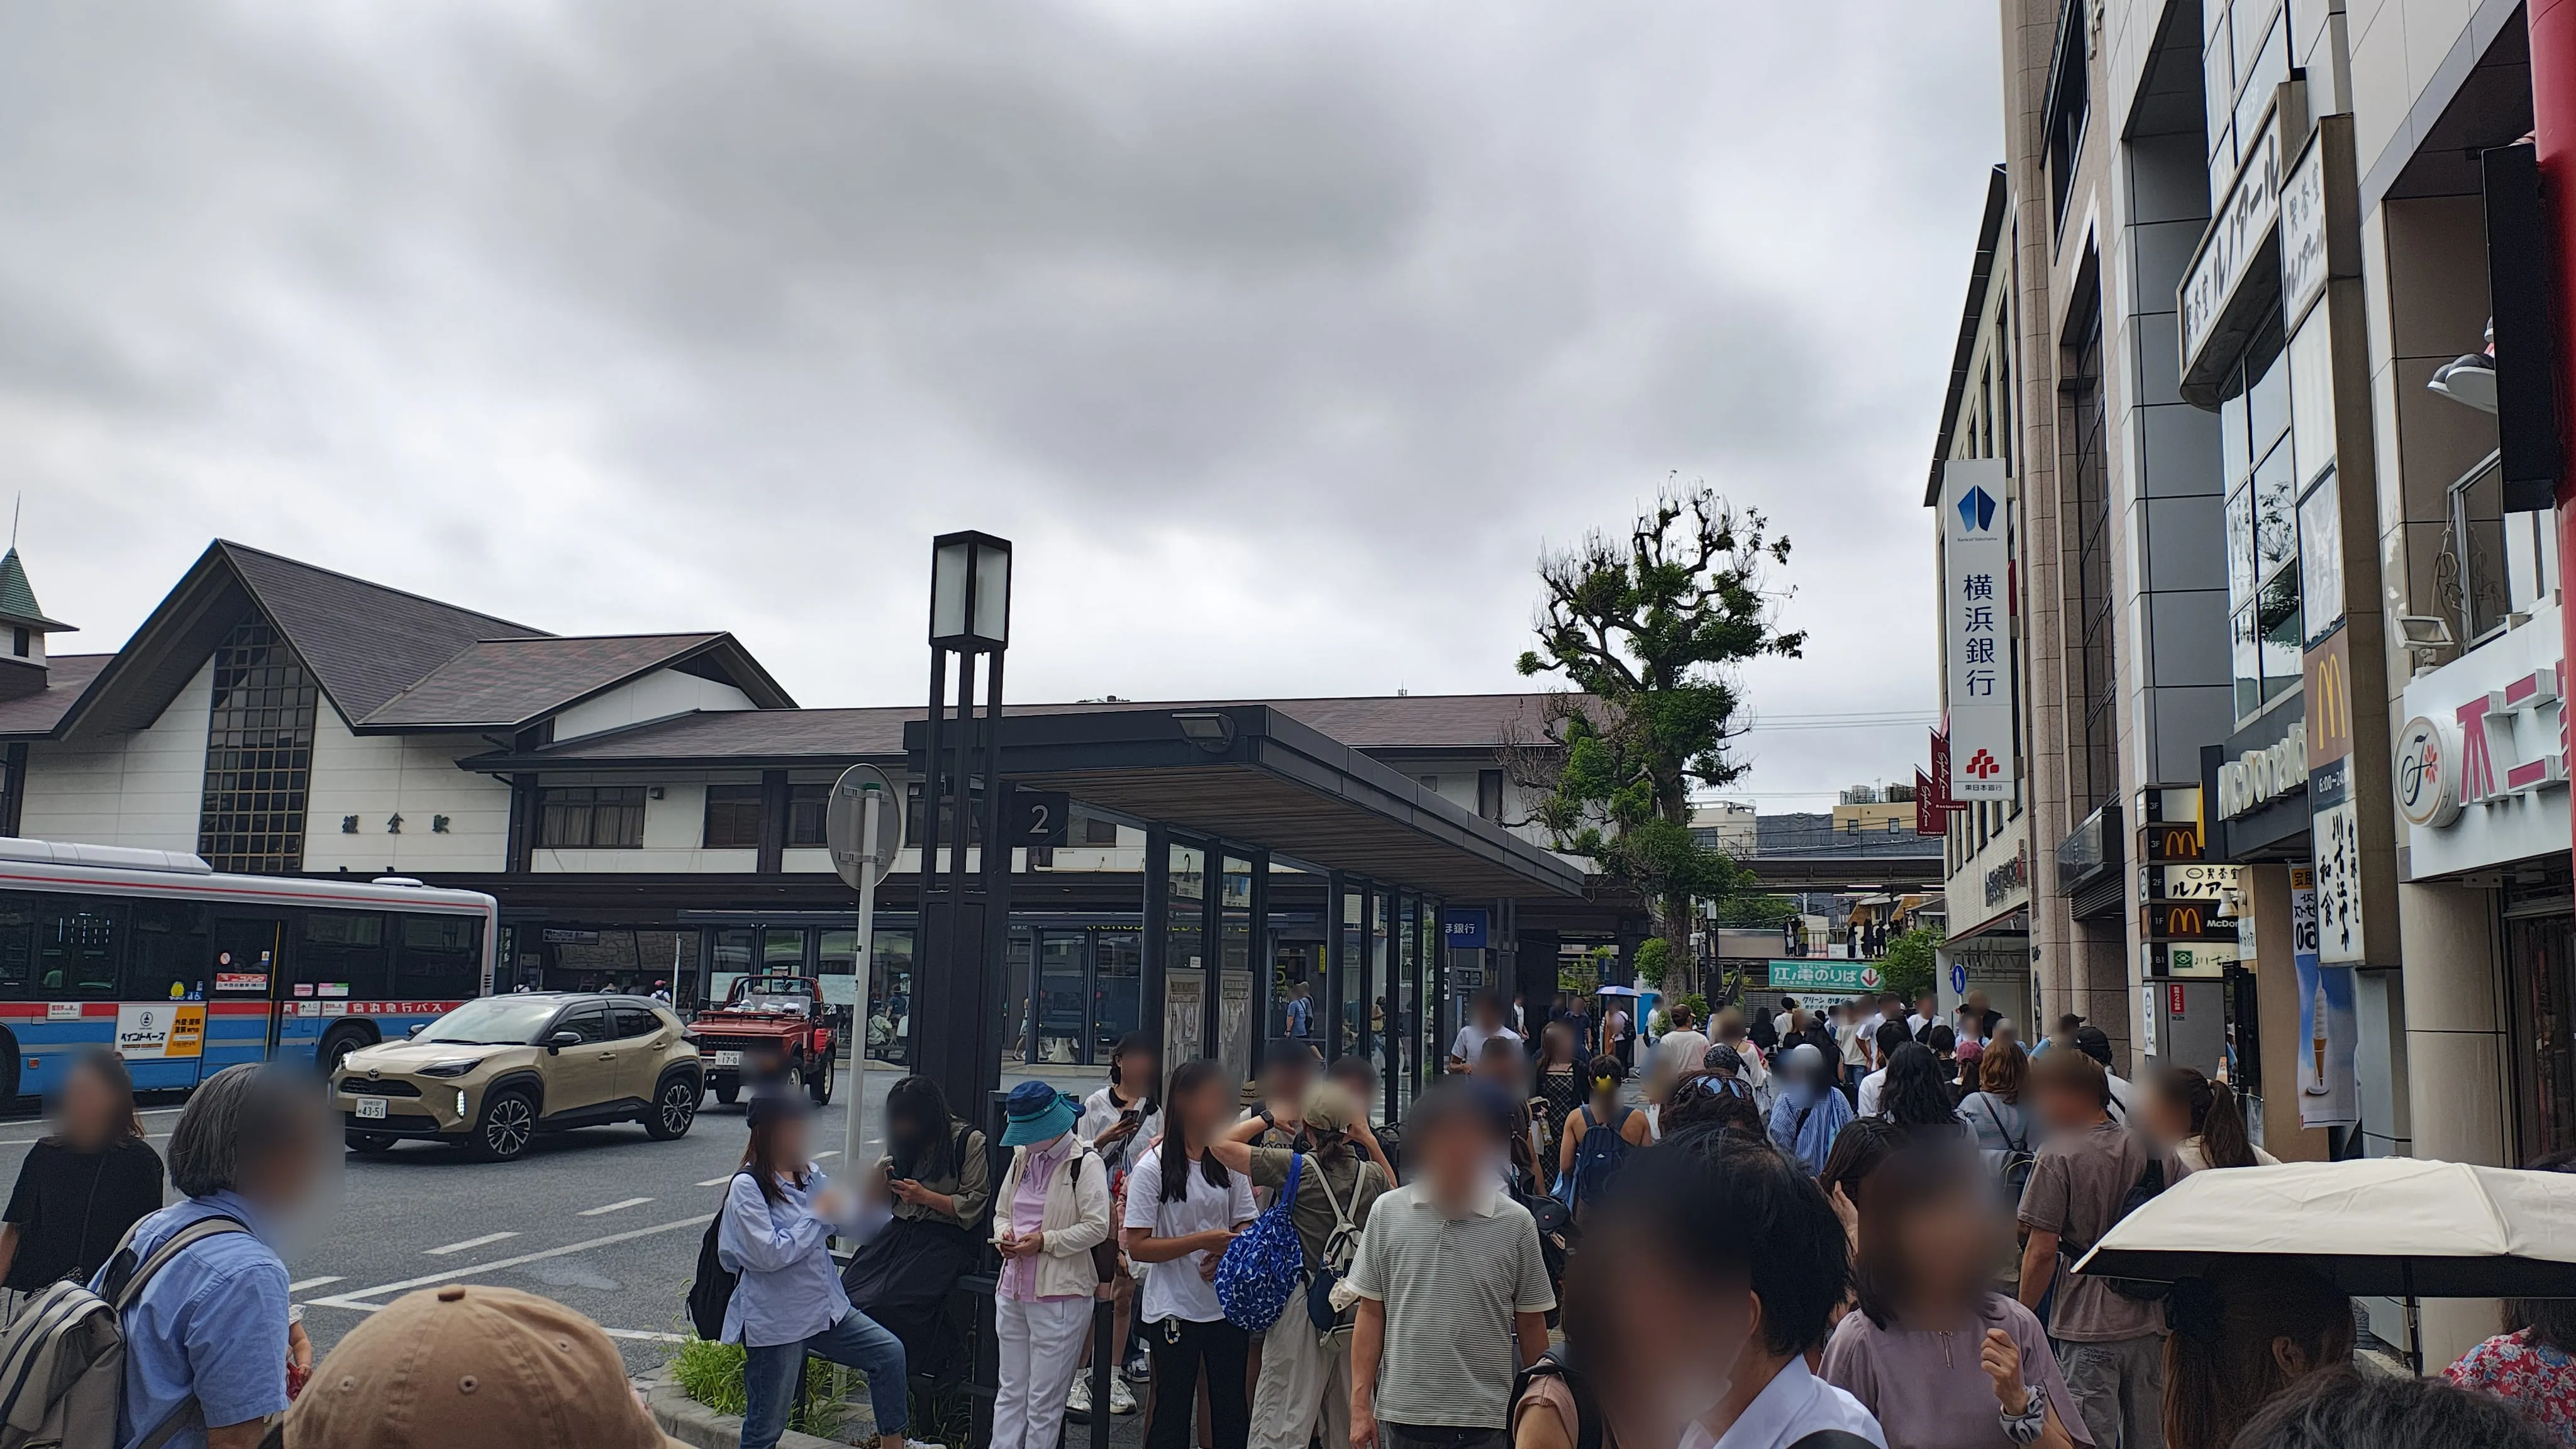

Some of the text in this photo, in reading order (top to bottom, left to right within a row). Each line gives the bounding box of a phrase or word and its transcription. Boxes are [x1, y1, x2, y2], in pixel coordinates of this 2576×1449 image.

[2214, 133, 2280, 313] ルノアール
[2285, 214, 2326, 306] ルノアール
[1963, 574, 1996, 697] 横浜銀行
[2455, 658, 2569, 808] 不二
[1964, 784, 2003, 792] 東日本銀行
[2149, 802, 2159, 810] 3F
[1028, 804, 1050, 835] 2
[2152, 879, 2162, 887] 2F
[2319, 853, 2334, 928] 和食
[2155, 917, 2164, 925] 1F
[1774, 967, 1858, 983] 江ノ電のりば
[352, 1002, 443, 1014] 京浜急行バス
